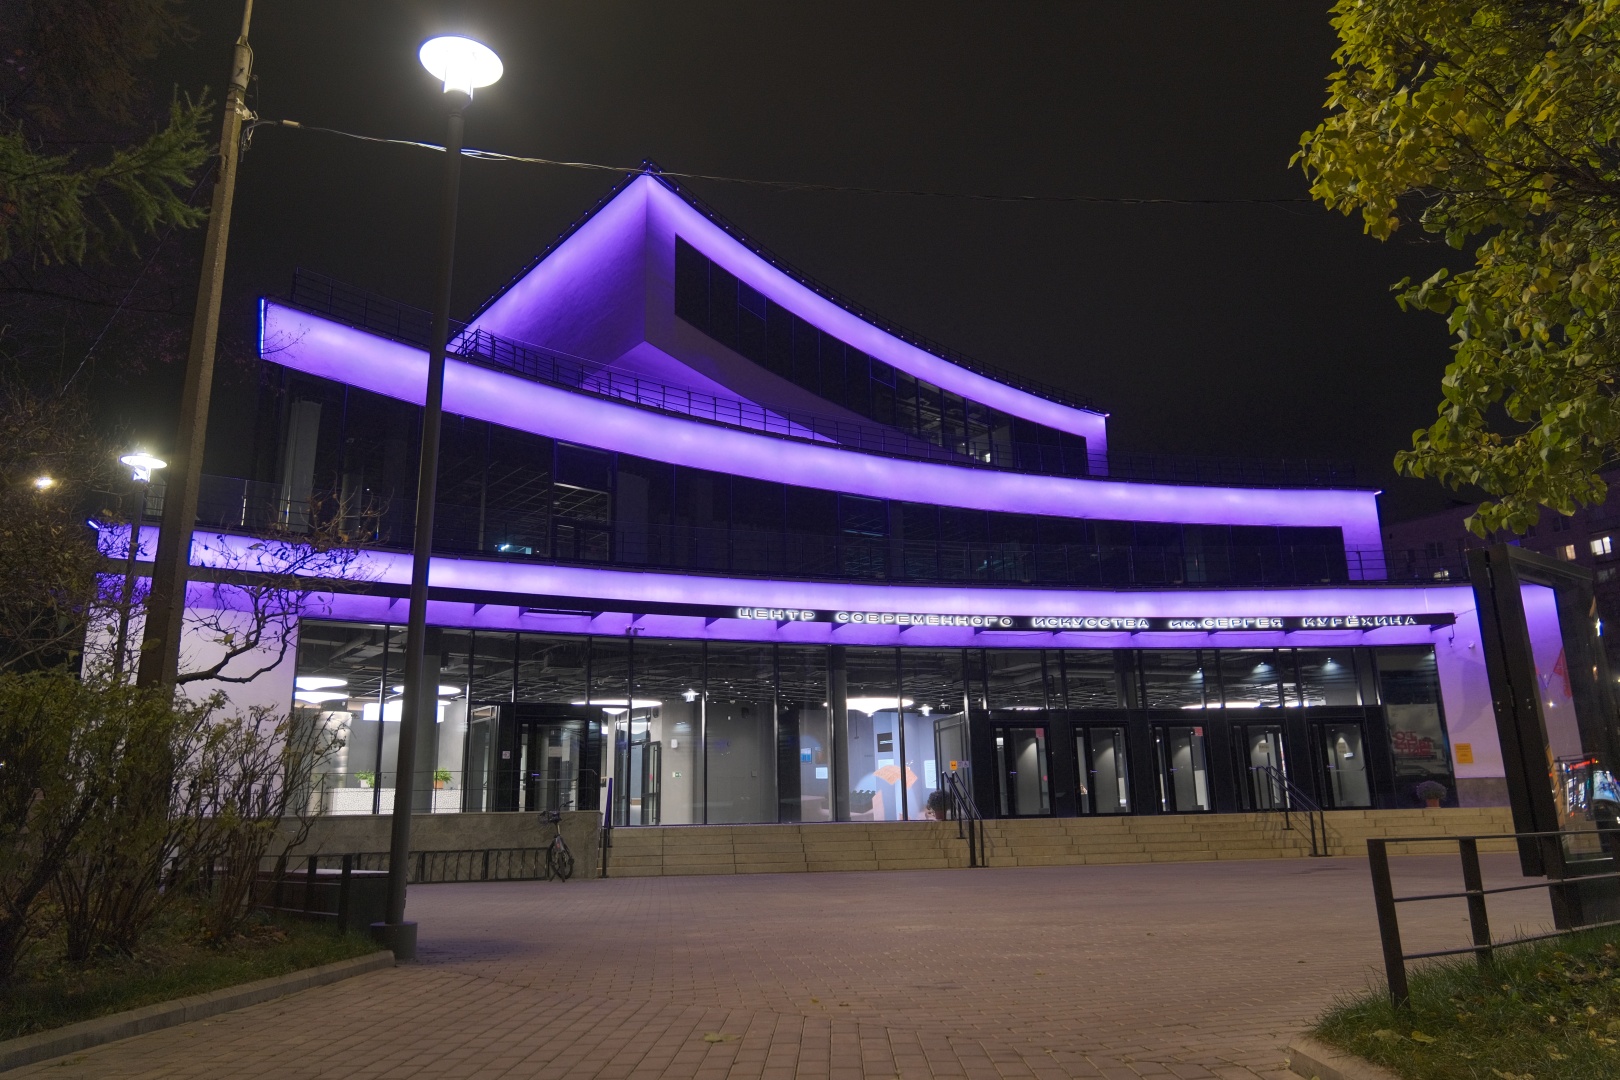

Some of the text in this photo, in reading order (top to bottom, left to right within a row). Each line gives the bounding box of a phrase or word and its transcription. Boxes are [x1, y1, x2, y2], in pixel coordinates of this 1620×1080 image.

[739, 608, 815, 621] ЦЕНТР
[835, 612, 1012, 627] СОВРЕМЕННОГО
[1032, 616, 1149, 629] ИСКУССТВА
[1302, 614, 1418, 627] КУРЁХИНА
